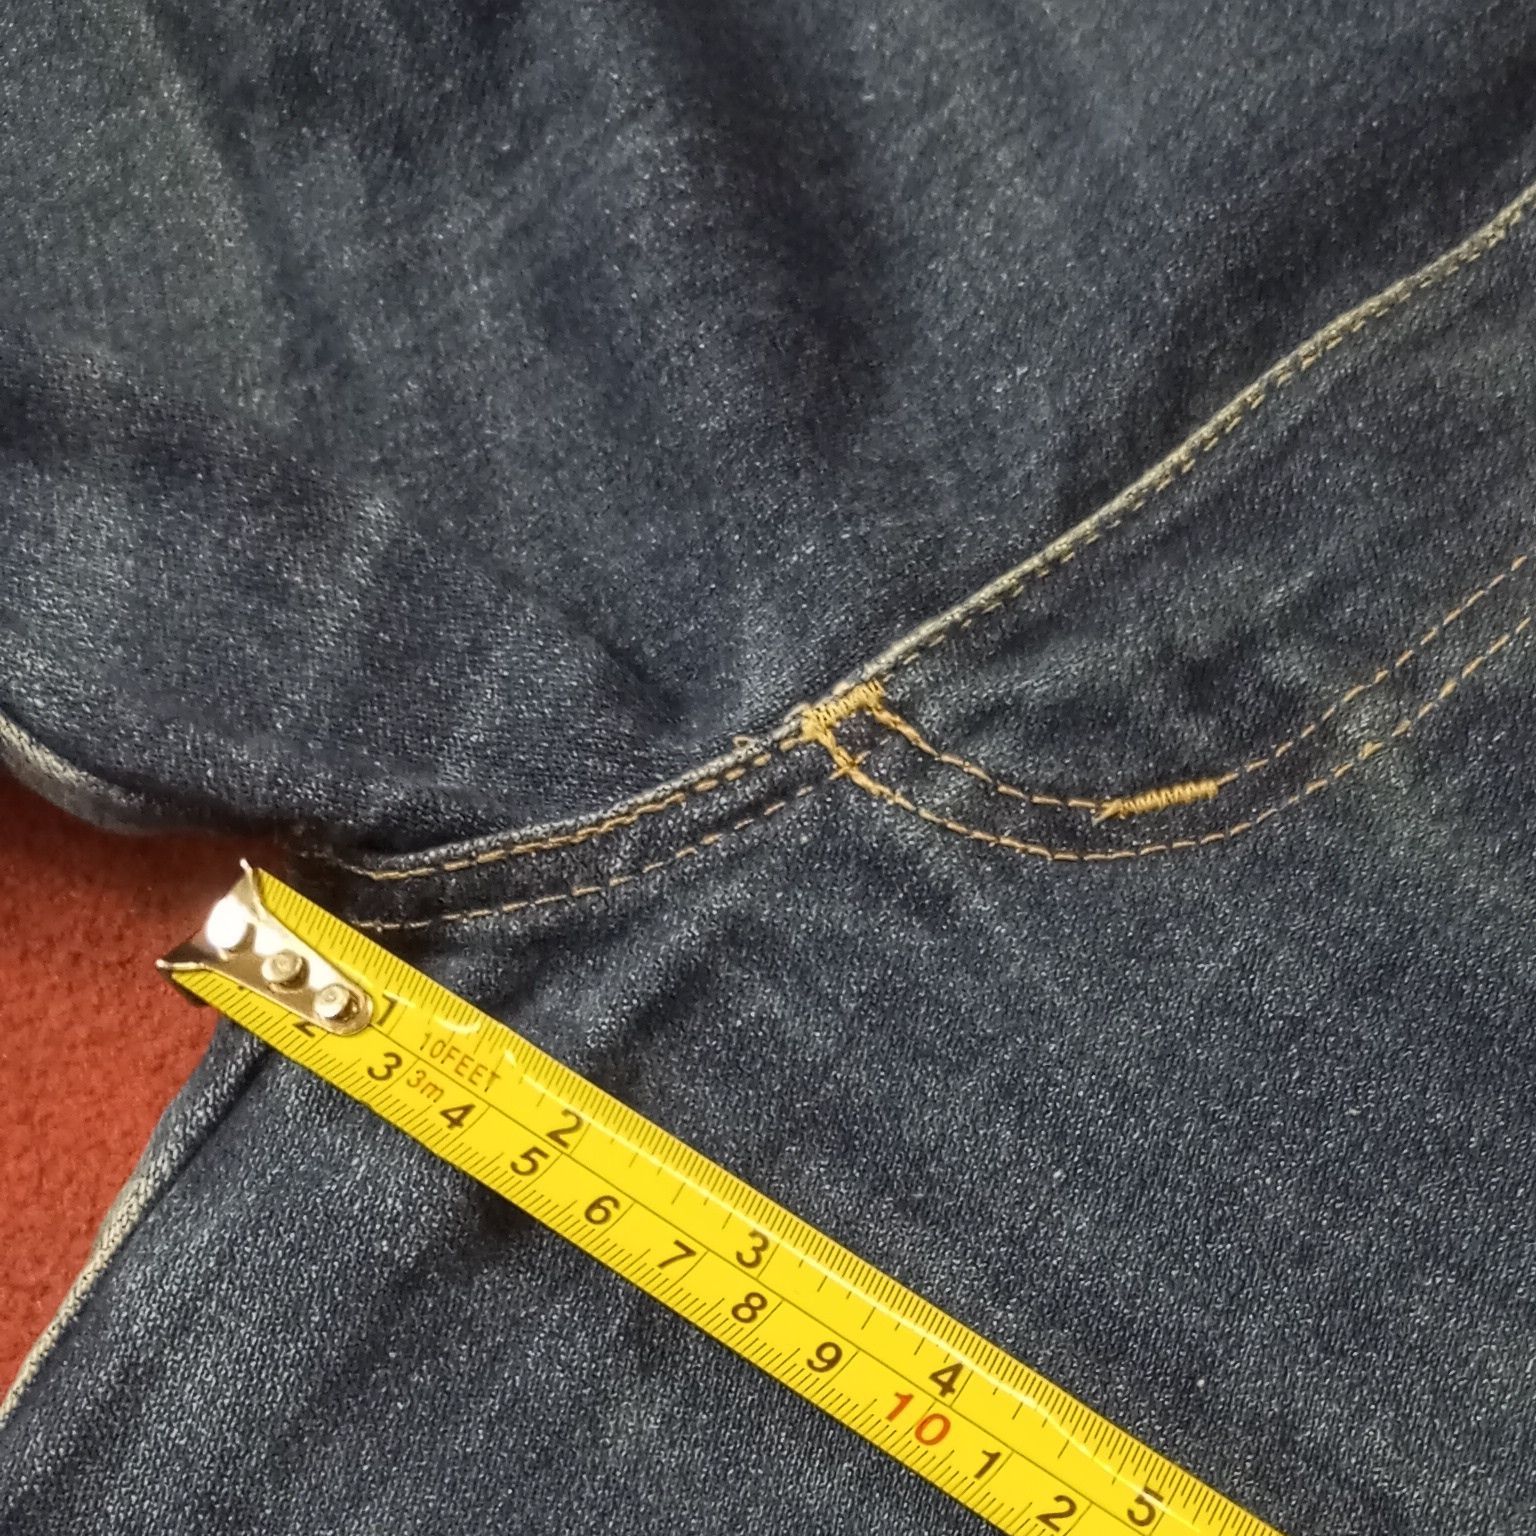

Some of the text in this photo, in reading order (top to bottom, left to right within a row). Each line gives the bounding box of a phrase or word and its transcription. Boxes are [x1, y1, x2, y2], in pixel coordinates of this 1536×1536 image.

[405, 1068, 446, 1103] 3m
[419, 1031, 502, 1093] 10FEET
[367, 1052, 403, 1083] 3
[440, 1102, 476, 1131] 4
[510, 1146, 549, 1178] 5
[584, 1195, 620, 1226] 6
[654, 1241, 696, 1270] 7
[731, 1292, 767, 1323] 8
[806, 1342, 842, 1373] 9
[885, 1392, 951, 1446] 10
[974, 1449, 1002, 1479] 1
[1037, 1495, 1076, 1532] 2
[546, 1109, 584, 1148] 2
[736, 1232, 769, 1269] 3
[930, 1362, 964, 1397] 4
[1127, 1487, 1164, 1526] 5
